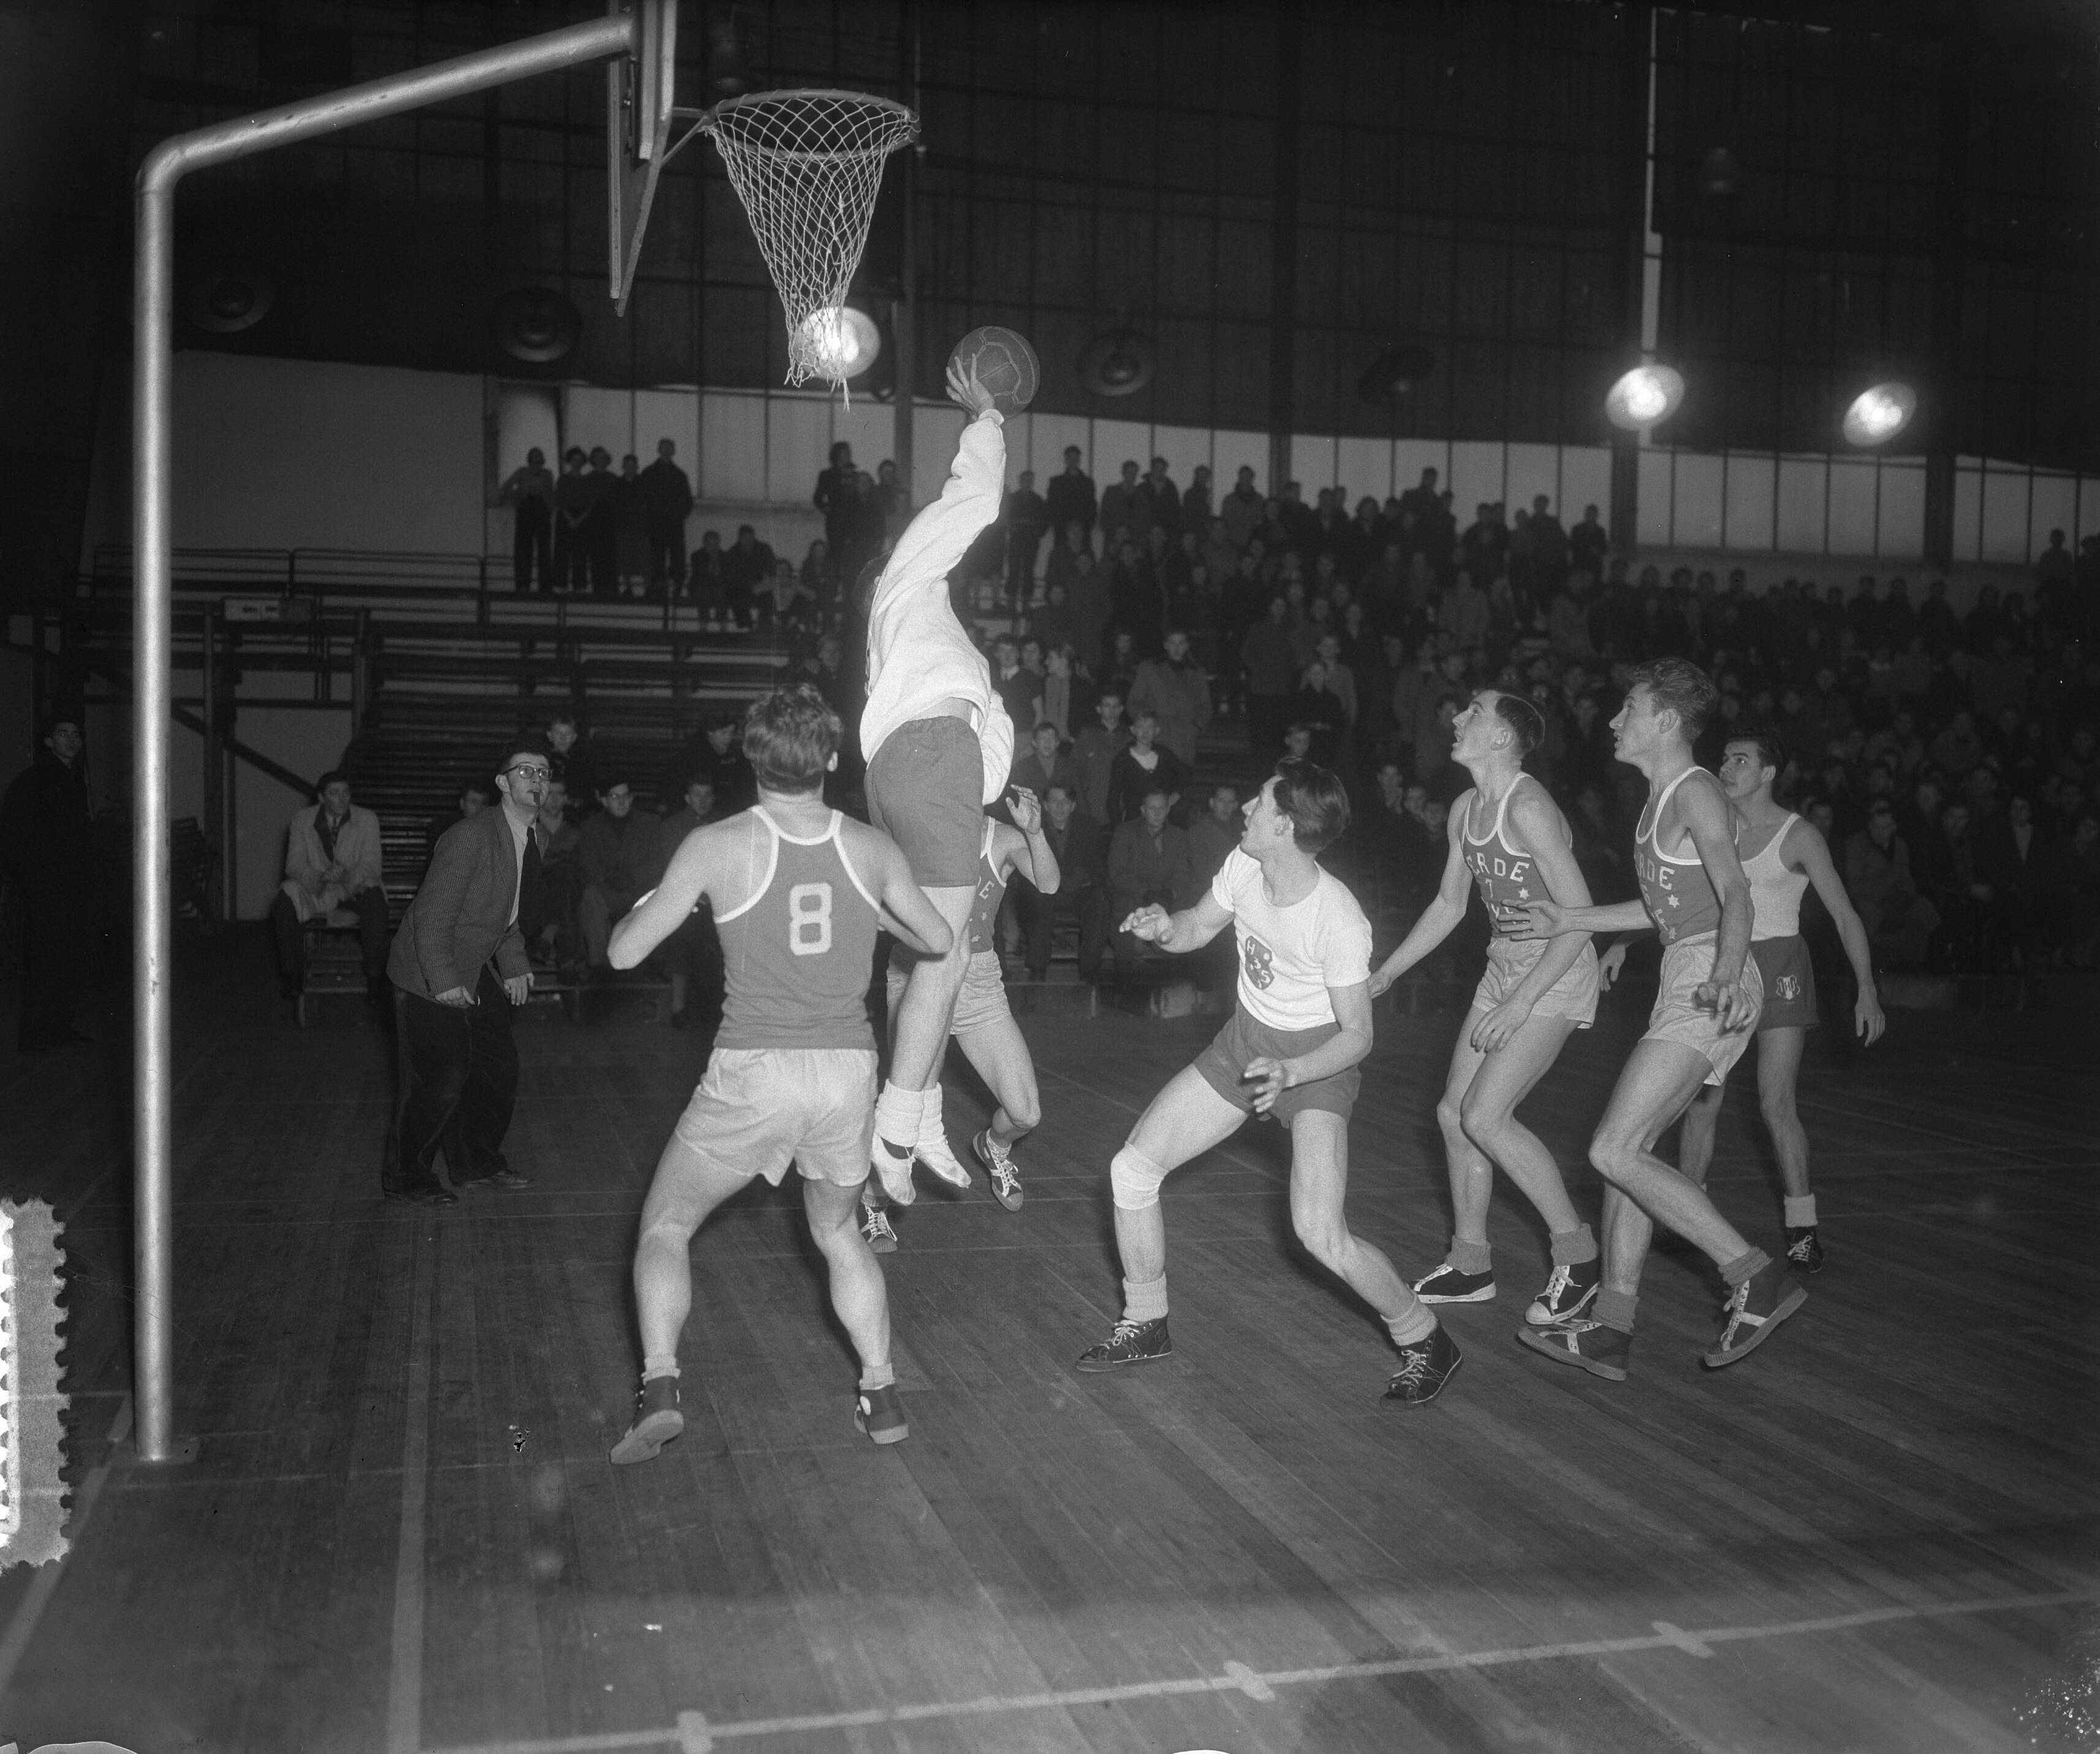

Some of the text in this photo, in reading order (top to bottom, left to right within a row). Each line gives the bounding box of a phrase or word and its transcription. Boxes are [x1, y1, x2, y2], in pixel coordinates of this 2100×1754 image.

[977, 876, 995, 901] E
[1634, 852, 1675, 890] RDE
[789, 882, 833, 956] 8
